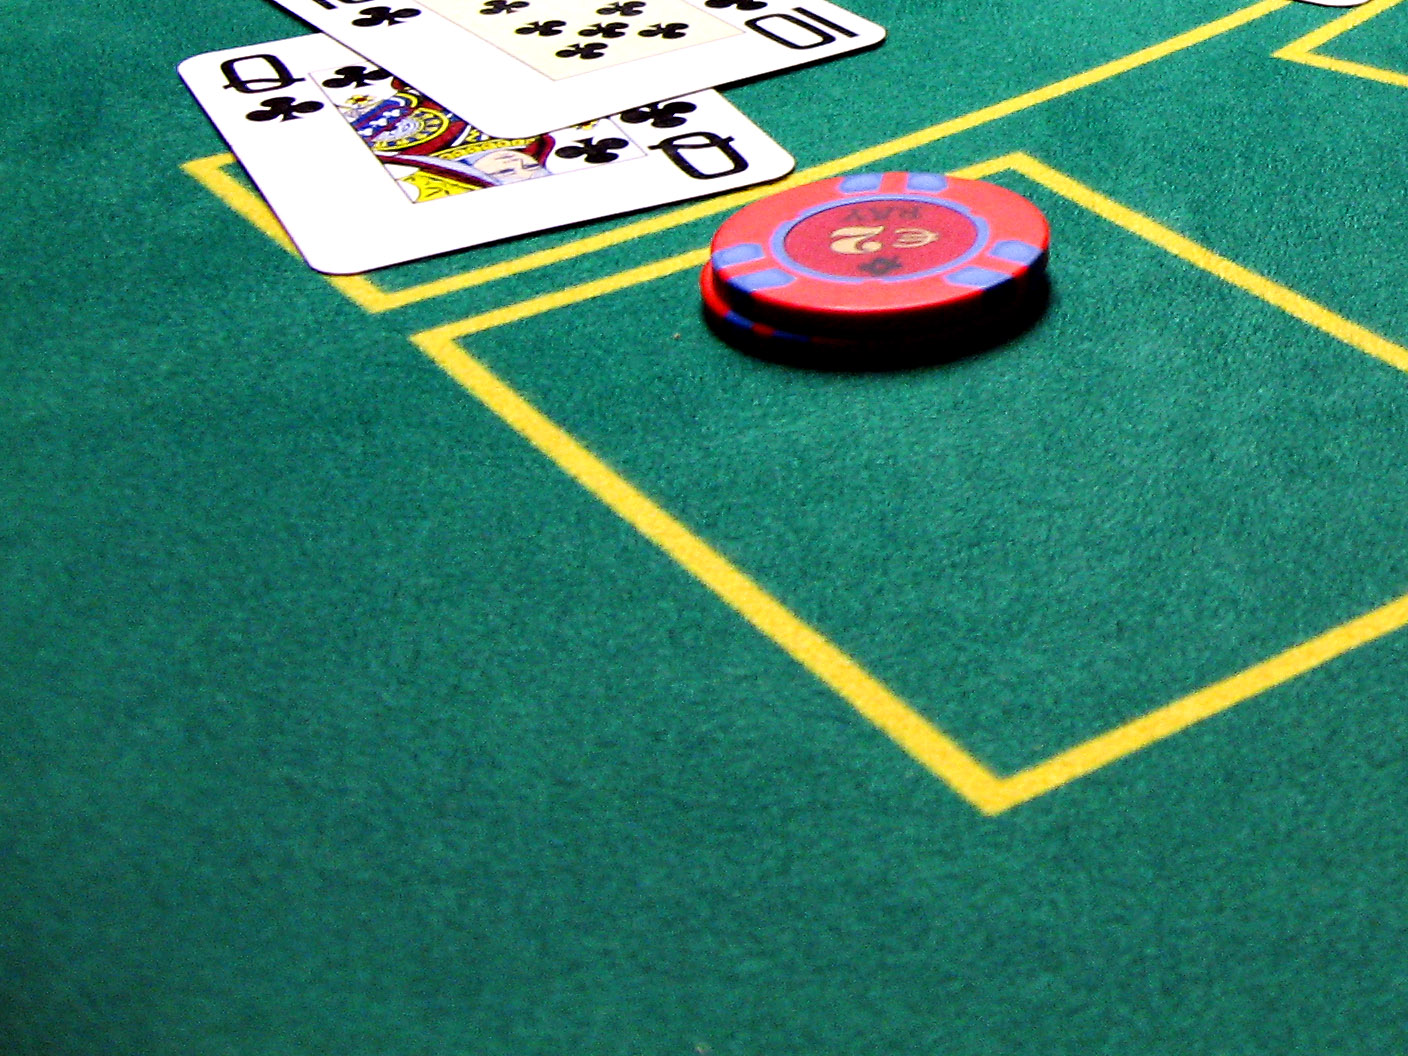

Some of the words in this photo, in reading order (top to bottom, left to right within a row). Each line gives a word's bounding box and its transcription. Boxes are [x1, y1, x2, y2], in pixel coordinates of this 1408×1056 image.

[744, 6, 861, 50] 10
[219, 53, 306, 95] Q
[647, 131, 749, 180] Q
